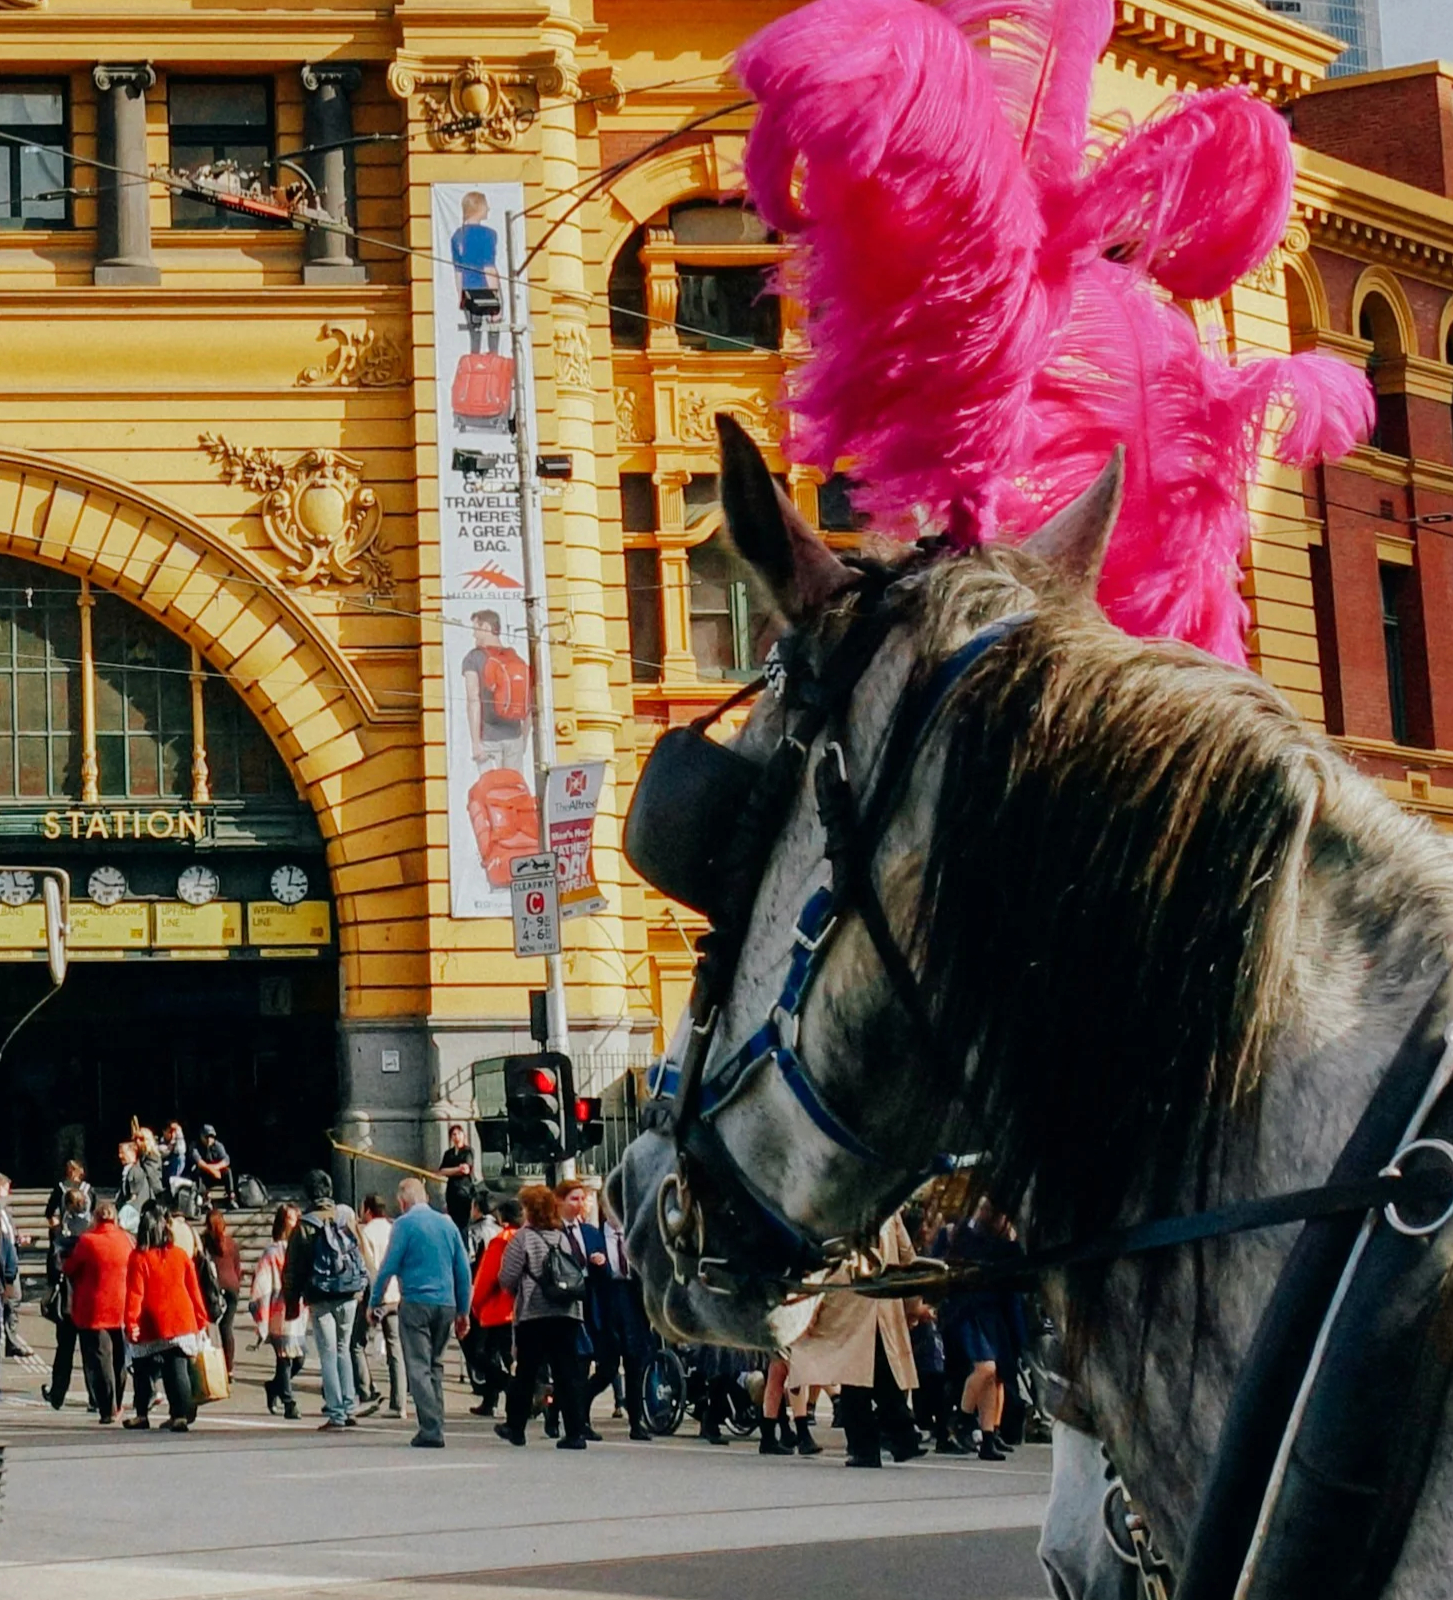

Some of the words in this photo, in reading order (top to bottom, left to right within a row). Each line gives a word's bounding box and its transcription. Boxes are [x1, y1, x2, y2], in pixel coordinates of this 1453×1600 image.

[457, 511, 522, 523] THERE'S
[458, 526, 469, 538] A
[474, 540, 511, 552] BAG.
[44, 810, 205, 840] STATION
[556, 849, 591, 881] DAY
[529, 893, 541, 913] C
[162, 919, 180, 927] LINE
[253, 918, 271, 927] LINE
